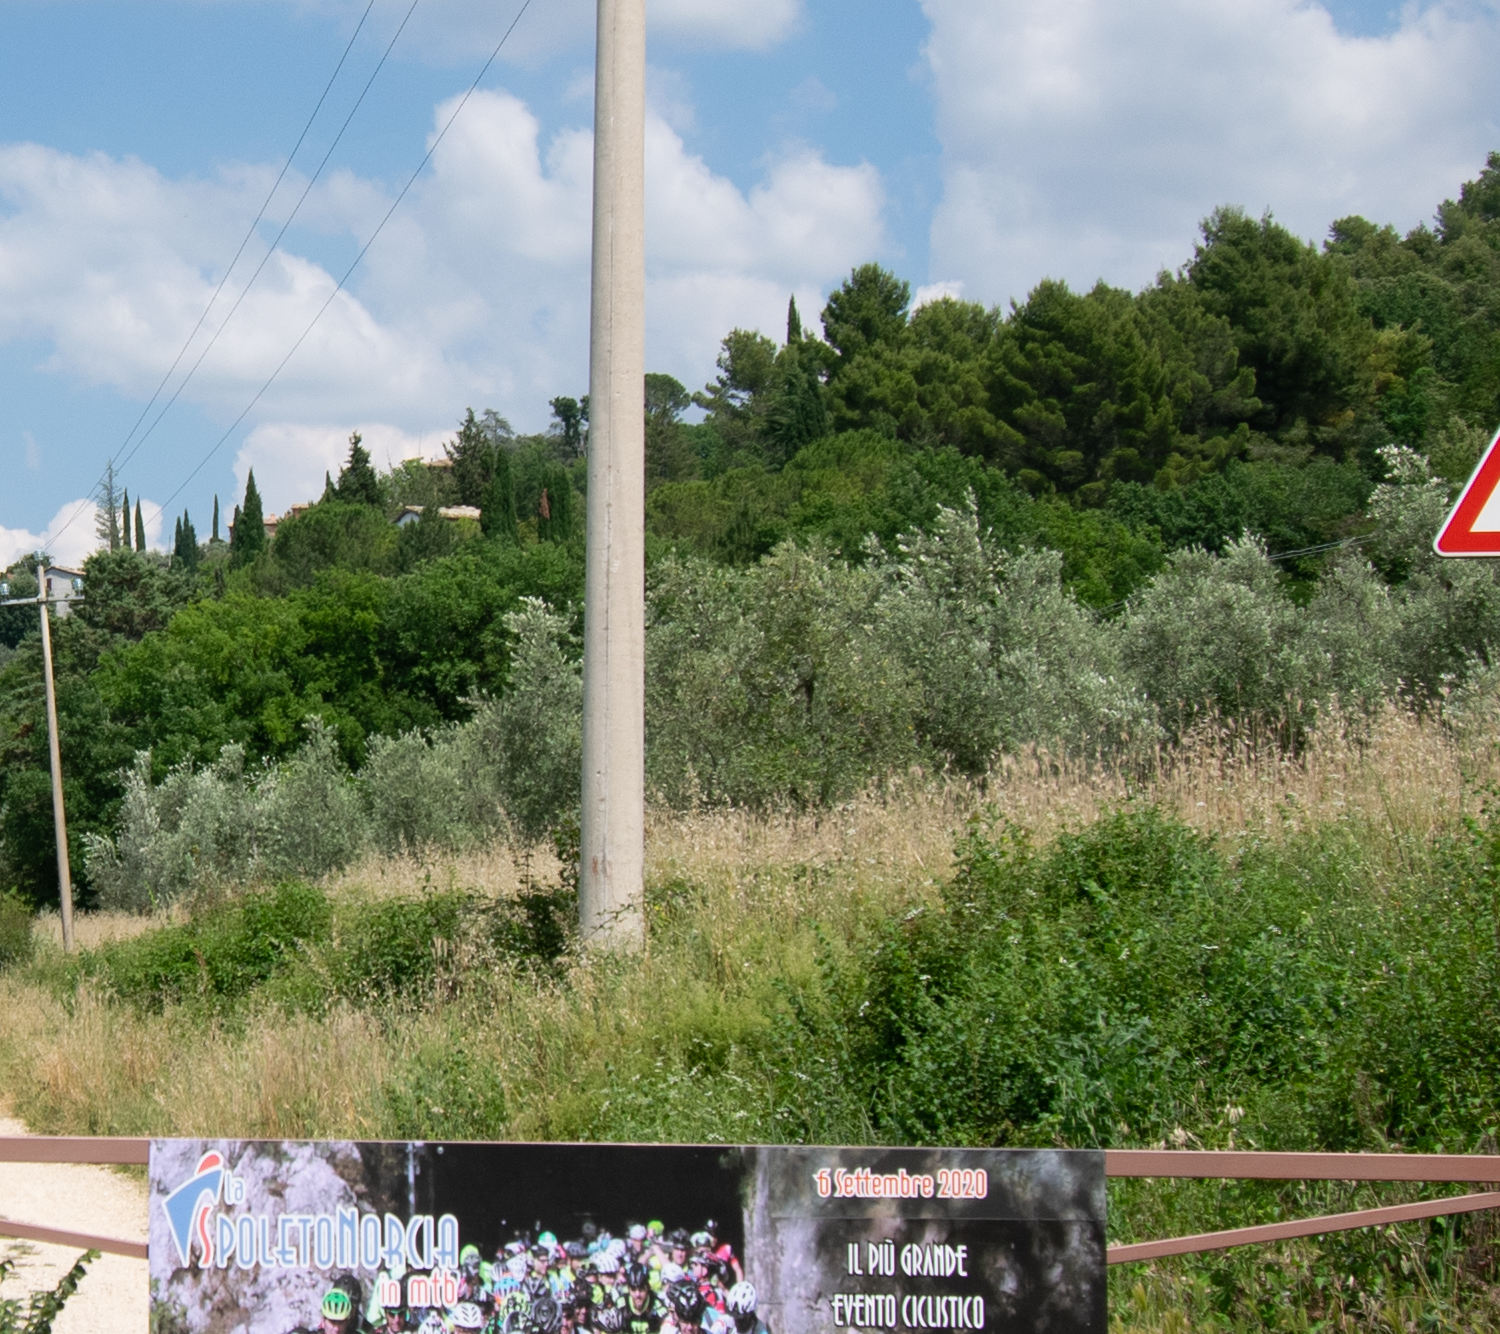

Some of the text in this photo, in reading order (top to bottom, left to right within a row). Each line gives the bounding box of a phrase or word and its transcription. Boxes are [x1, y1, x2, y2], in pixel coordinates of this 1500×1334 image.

[224, 1170, 246, 1204] la
[814, 1167, 988, 1199] 6 Settembre 2020
[848, 1239, 968, 1277] IL PIÙ GRANDE
[379, 1269, 459, 1307] in mtb
[832, 1294, 985, 1329] EVENTO CICLISTICO
